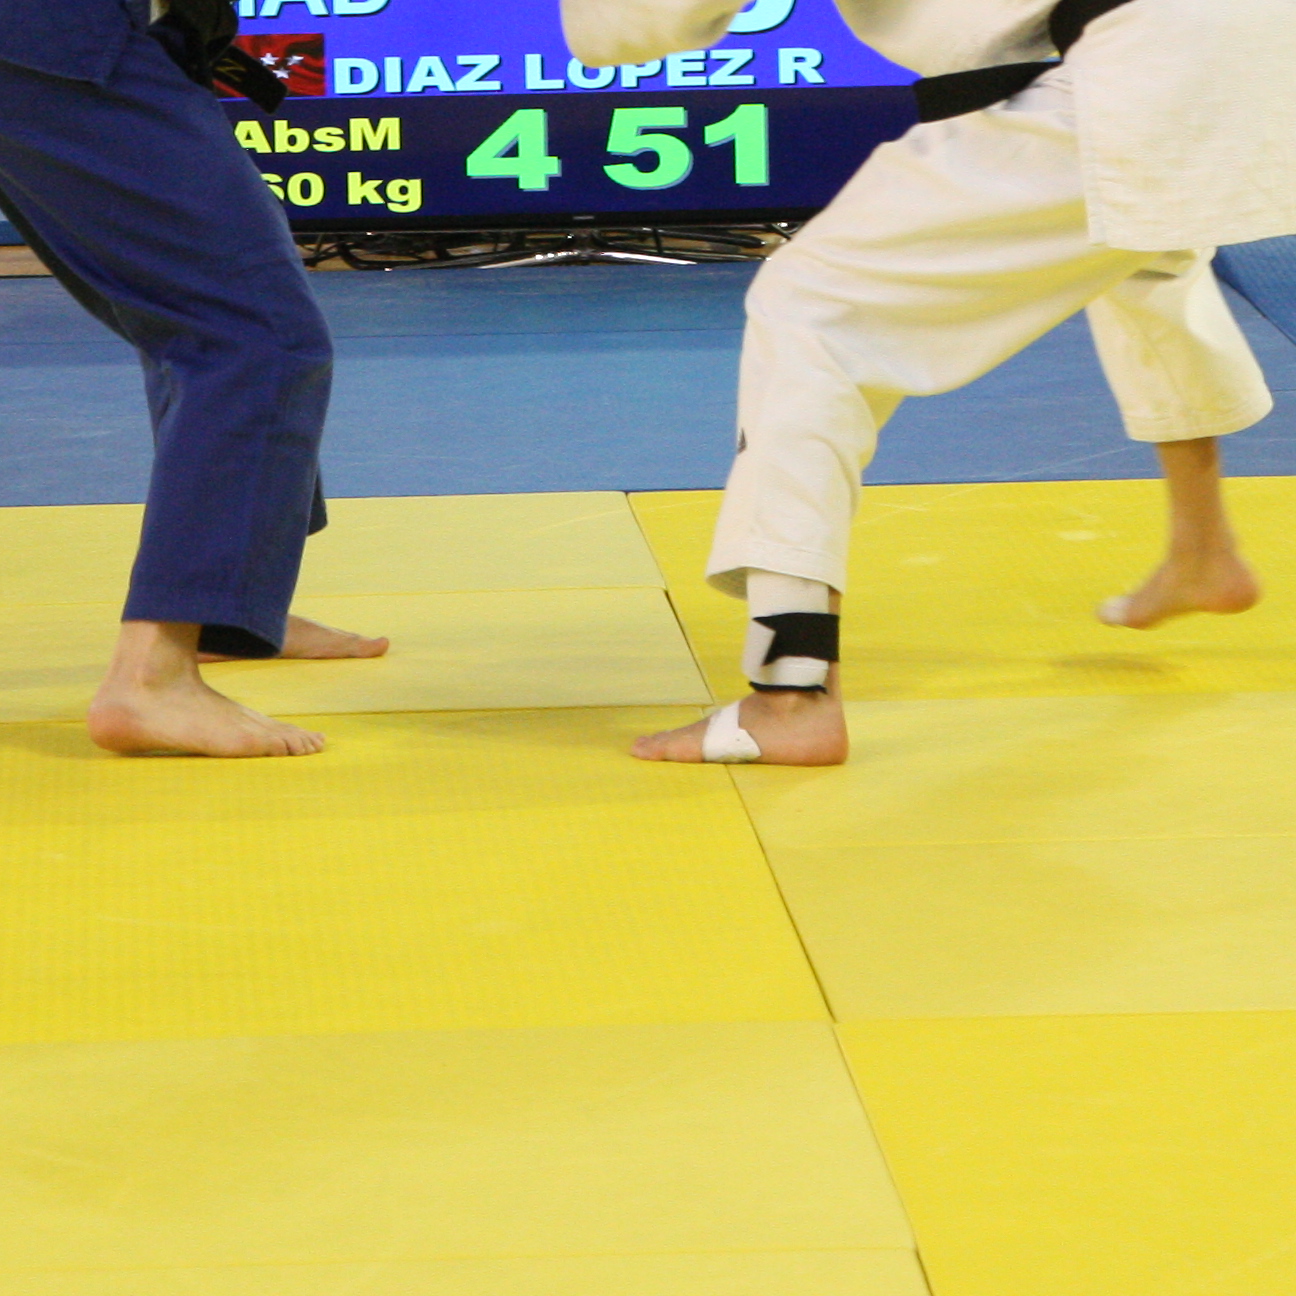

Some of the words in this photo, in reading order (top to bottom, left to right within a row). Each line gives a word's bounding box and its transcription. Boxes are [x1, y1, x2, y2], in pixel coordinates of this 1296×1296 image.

[333, 54, 502, 95] DIAZ
[524, 49, 756, 91] LOPEZ
[777, 47, 826, 85] R
[234, 116, 402, 154] AbsM
[465, 107, 562, 192] 4
[603, 103, 770, 191] 51
[347, 170, 424, 213] kg
